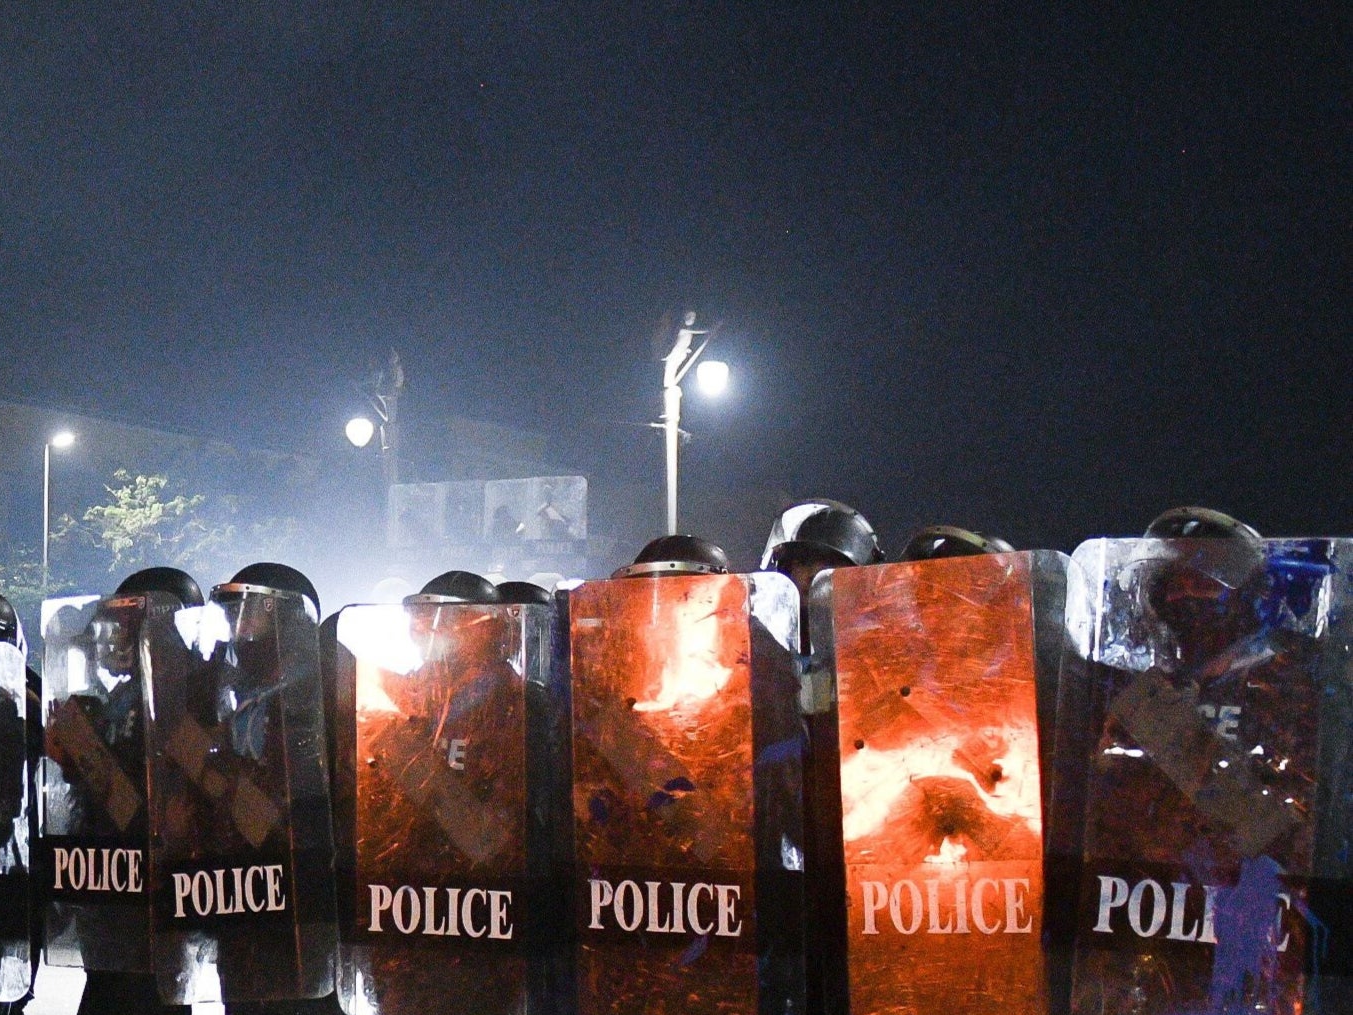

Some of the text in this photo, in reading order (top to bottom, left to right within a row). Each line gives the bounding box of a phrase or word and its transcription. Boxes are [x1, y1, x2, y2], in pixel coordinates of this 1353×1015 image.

[54, 848, 142, 892] POLICE
[172, 865, 285, 917] POLICE
[368, 885, 513, 939] POLICE
[588, 879, 742, 936] POLICE
[860, 876, 1033, 934] POLICE
